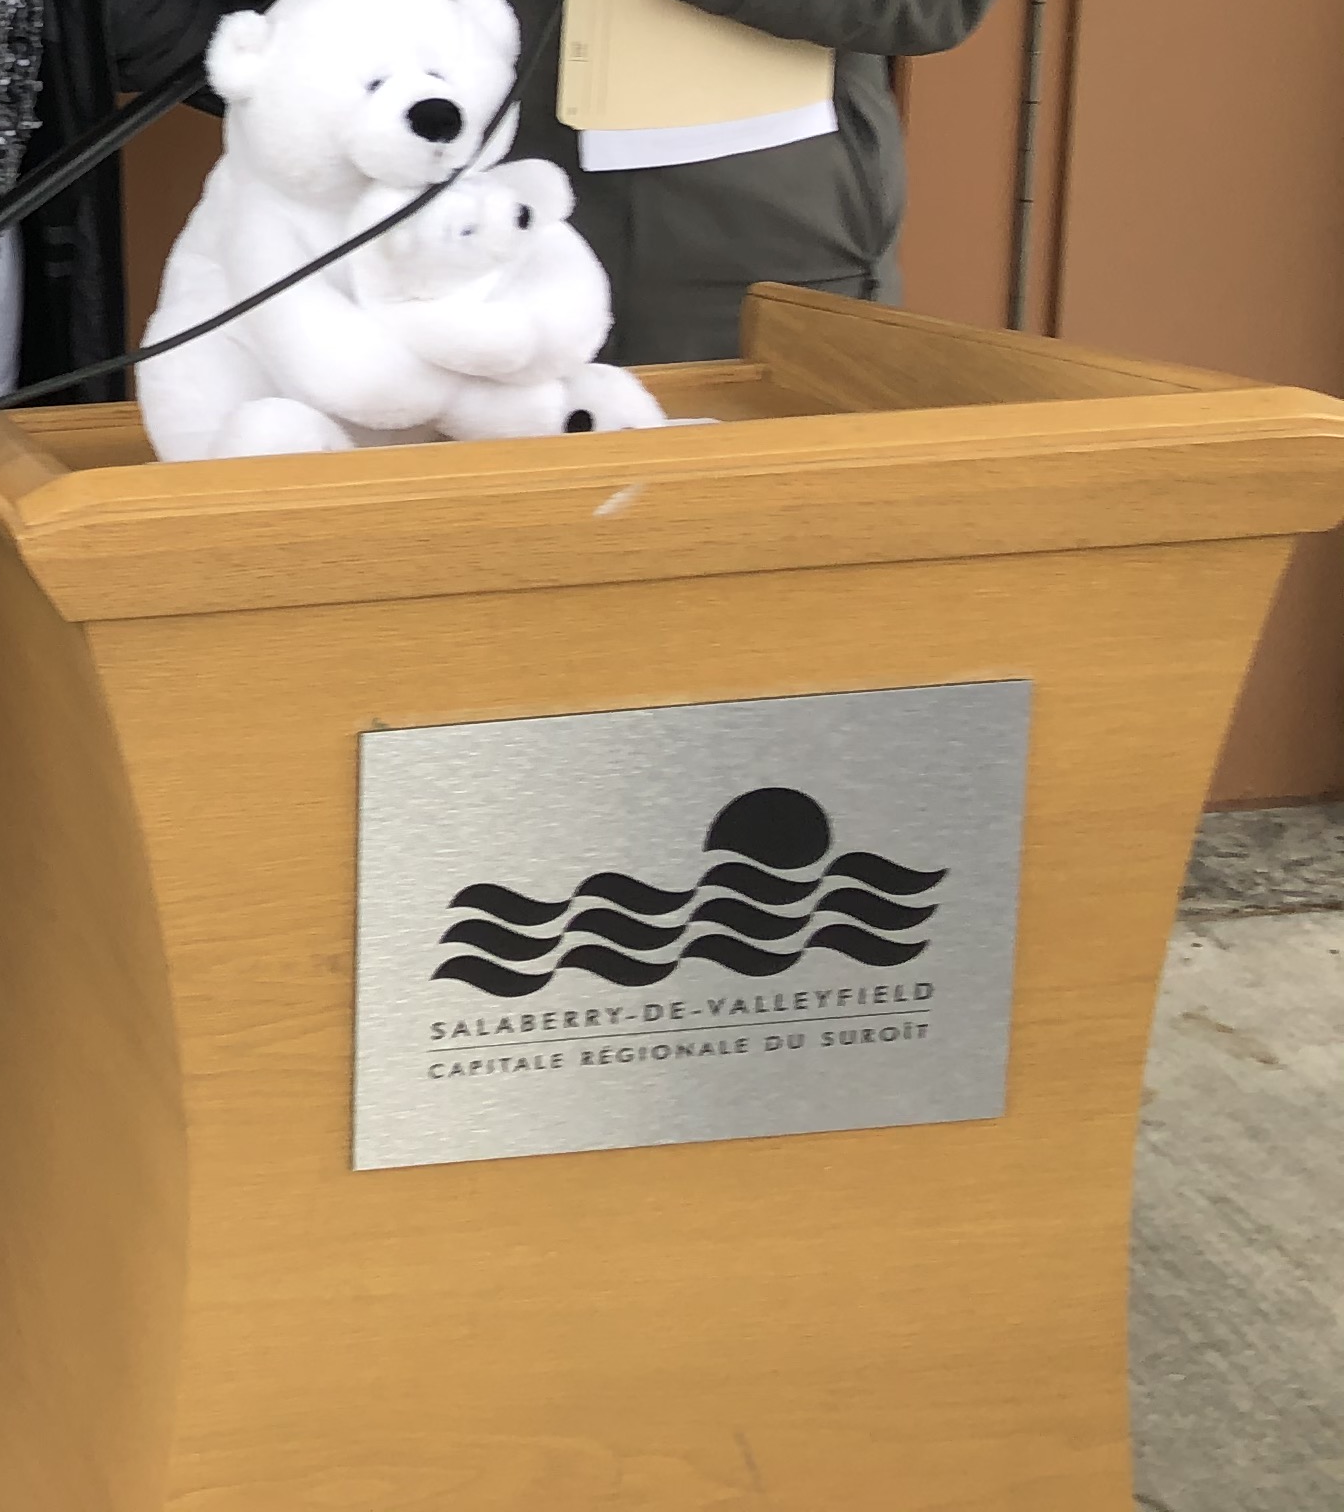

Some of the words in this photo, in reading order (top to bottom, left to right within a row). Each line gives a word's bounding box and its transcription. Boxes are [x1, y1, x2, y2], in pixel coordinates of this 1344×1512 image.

[429, 982, 935, 1041] SALABERRY-DE-VALLEYFIELD
[427, 1052, 564, 1080] CAPITALE
[579, 1037, 749, 1066] RÉGIONALE
[764, 1032, 806, 1052] DU
[820, 1021, 929, 1048] SUROÎT
